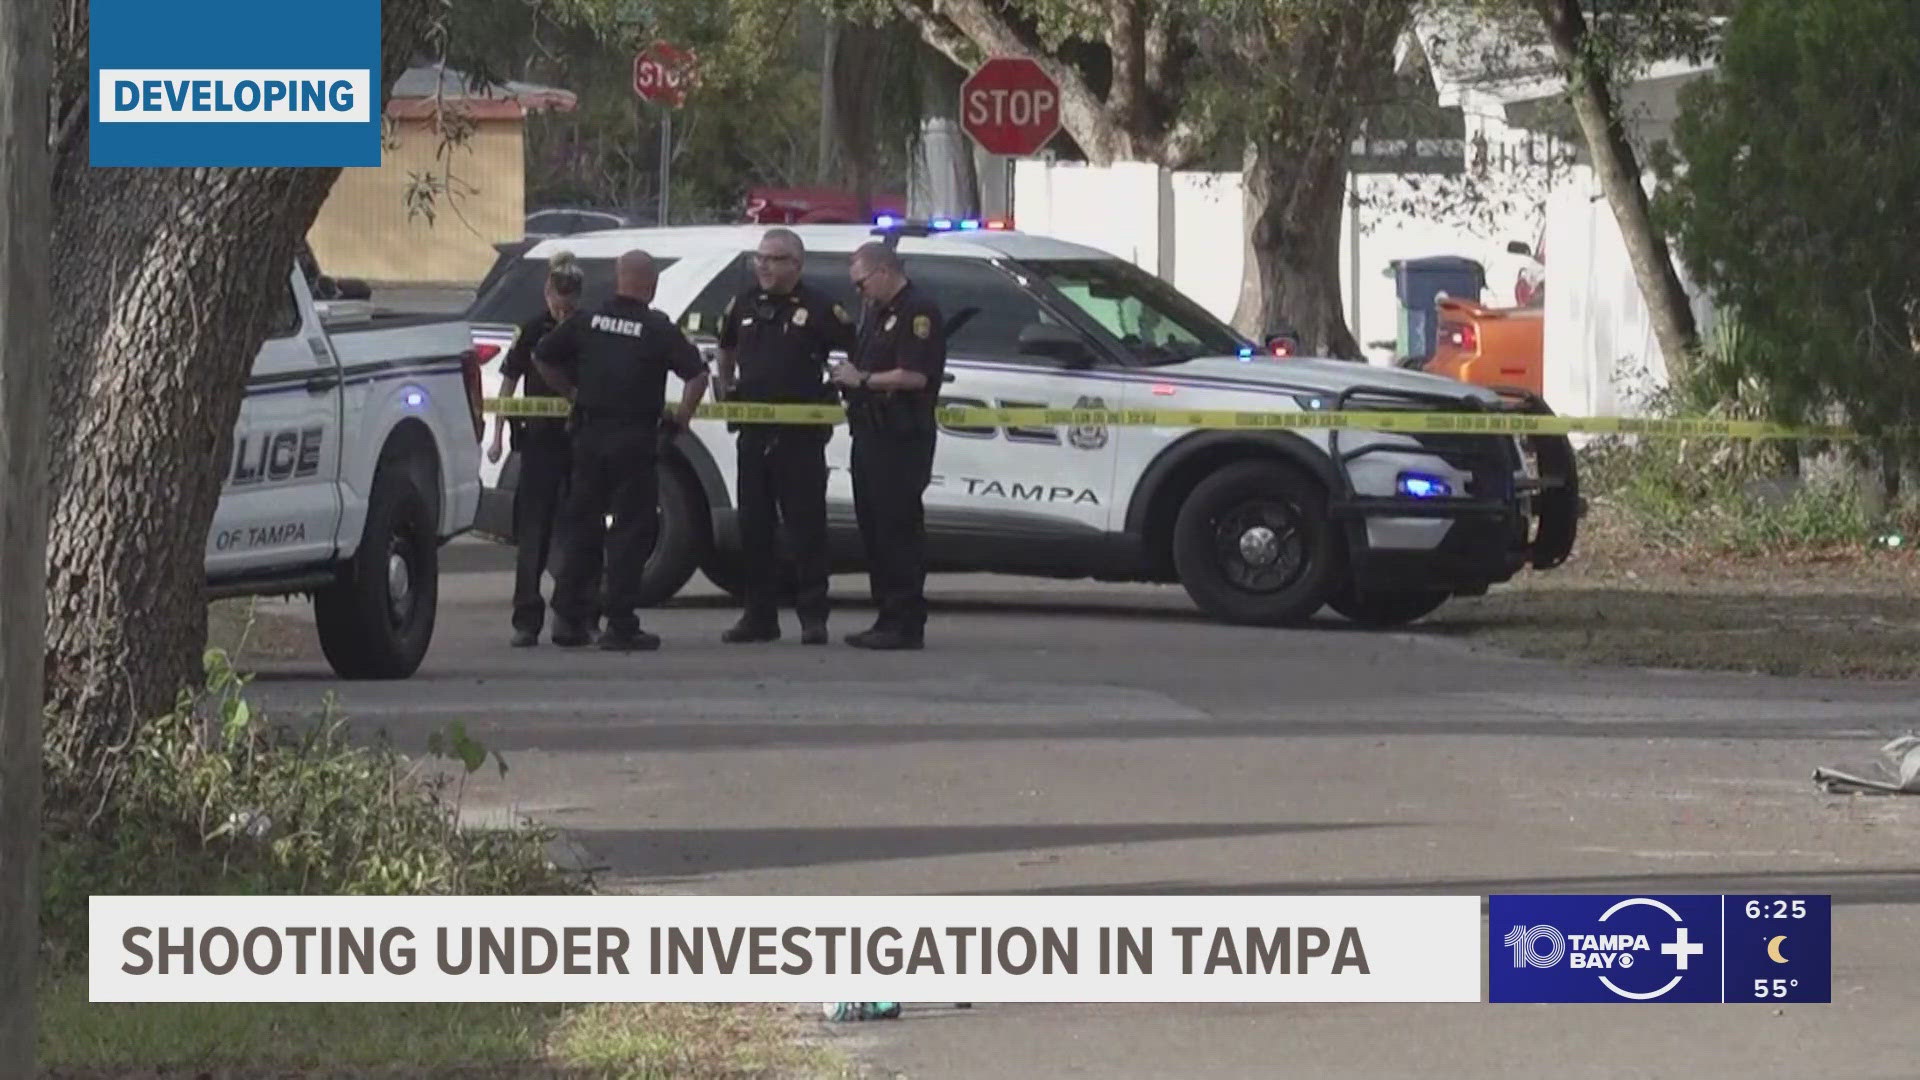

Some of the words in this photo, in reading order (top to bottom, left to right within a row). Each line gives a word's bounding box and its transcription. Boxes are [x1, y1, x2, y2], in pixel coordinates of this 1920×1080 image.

[640, 61, 696, 88] STO
[968, 89, 1055, 126] STOP
[591, 314, 643, 337] POLICE
[229, 426, 323, 485] LICE
[961, 477, 1100, 505] TAMPA
[216, 529, 241, 551] OF
[249, 523, 305, 547] TAMPA
